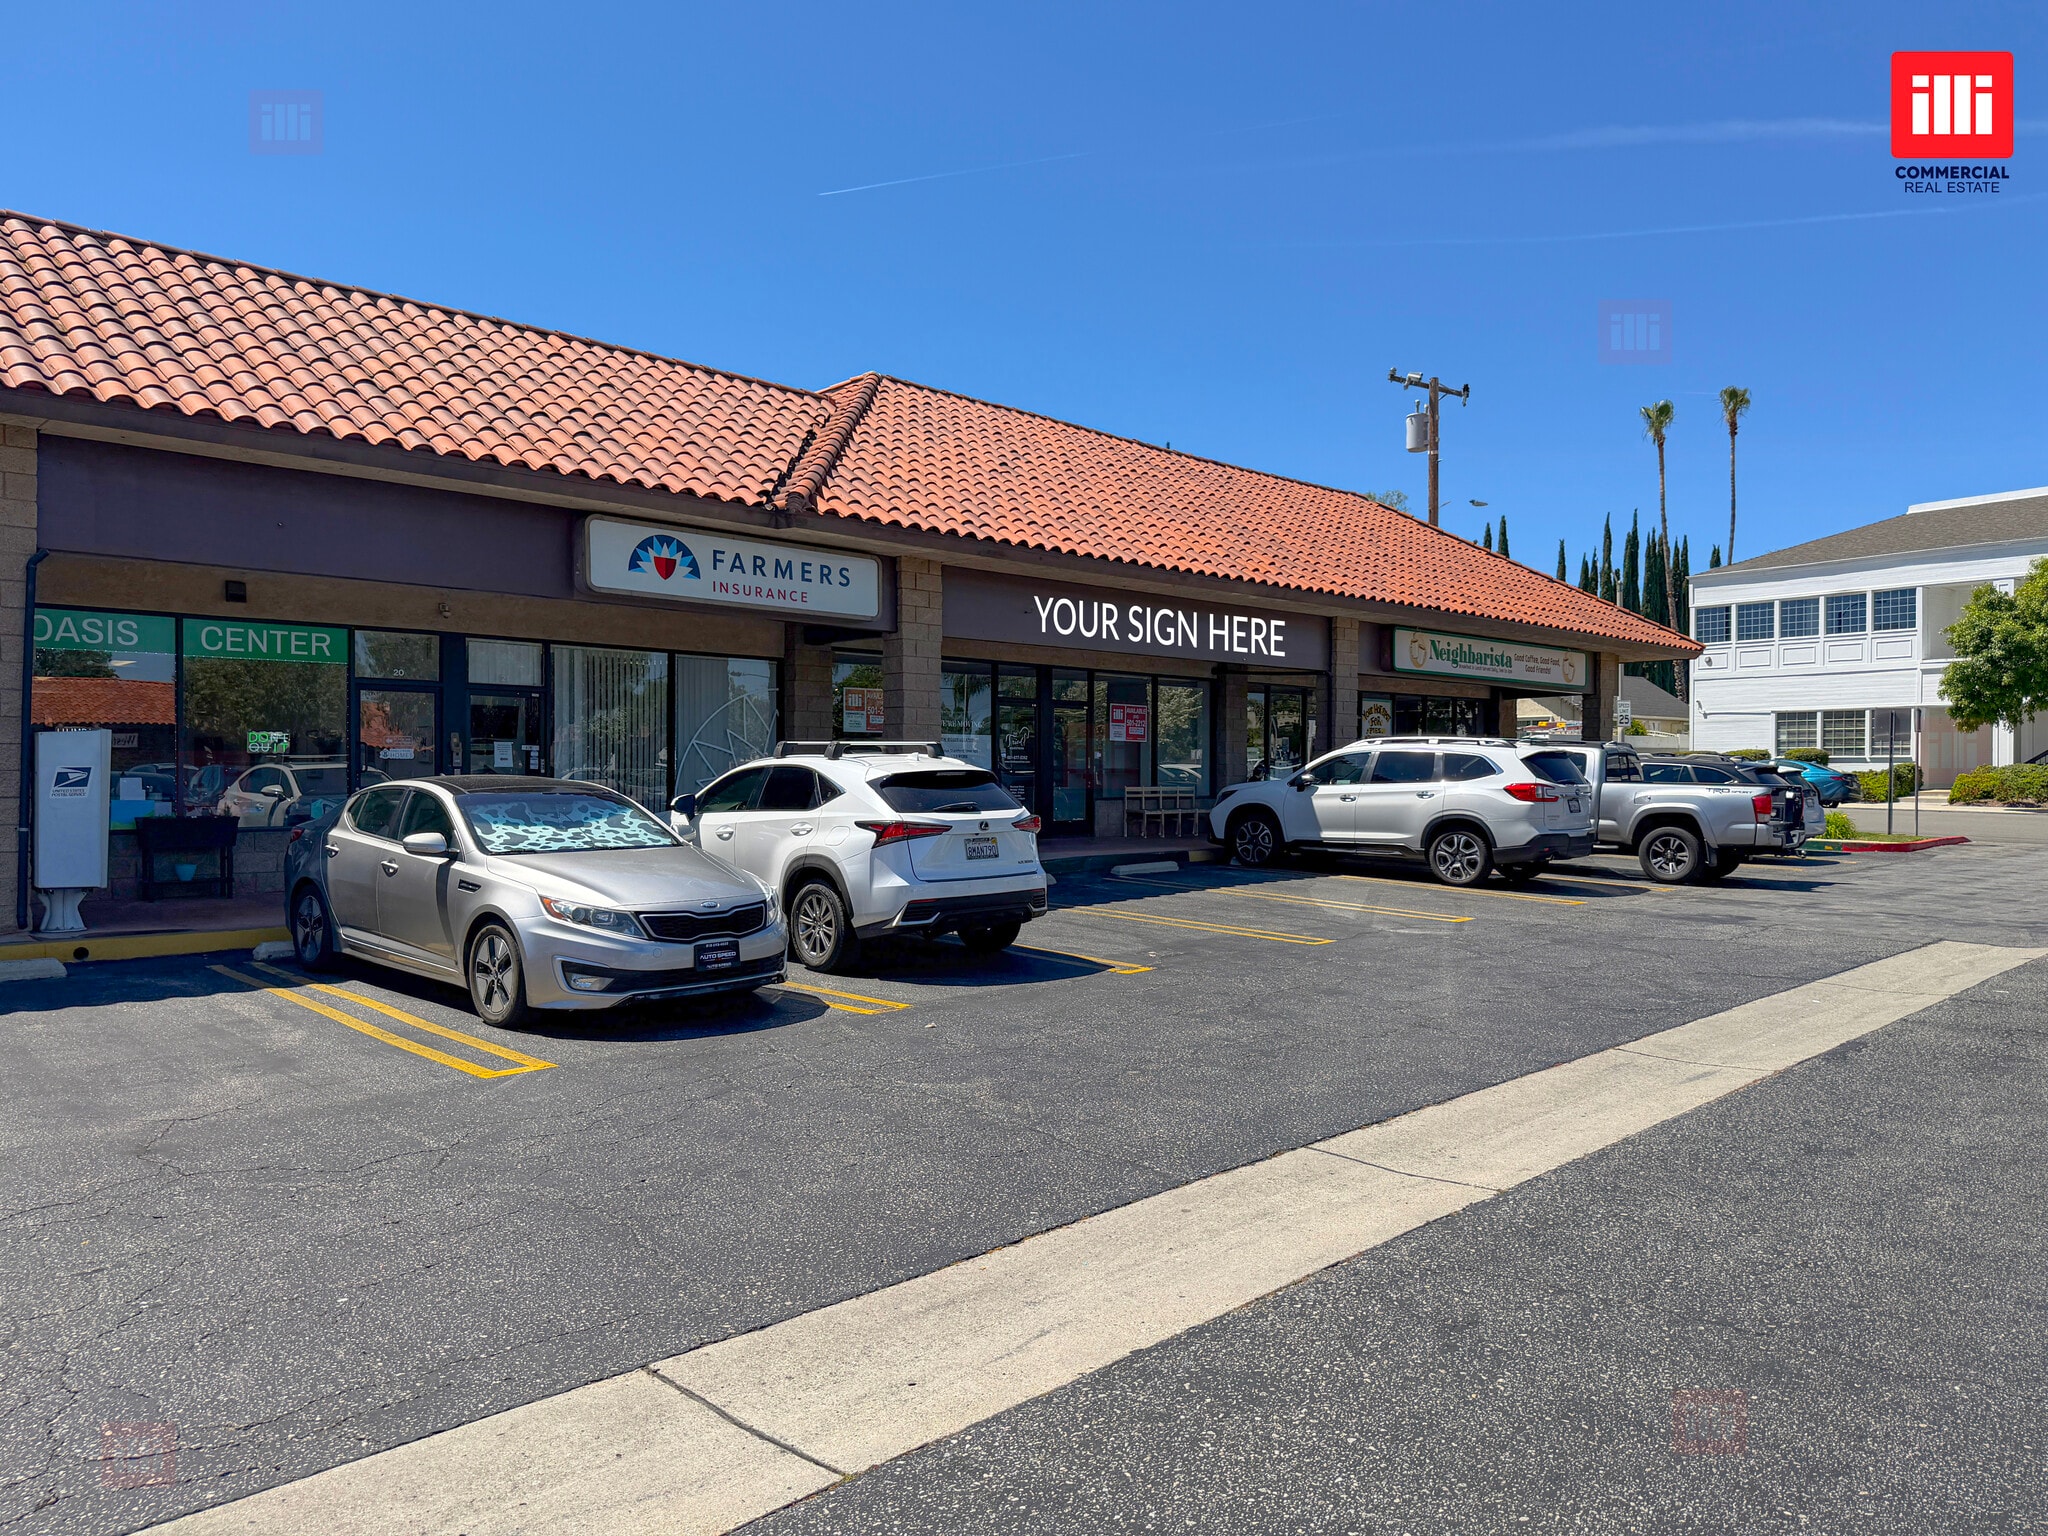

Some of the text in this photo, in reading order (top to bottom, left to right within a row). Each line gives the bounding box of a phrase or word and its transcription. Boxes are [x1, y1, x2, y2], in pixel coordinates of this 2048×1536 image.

[713, 550, 850, 587] FARMERS
[713, 581, 808, 603] INSURANCE
[33, 615, 331, 656] OASIS CENTER
[1034, 596, 1286, 657] YOUR SIGN HERE
[1429, 639, 1512, 668] Neighbarista
[1619, 715, 1629, 724] 25
